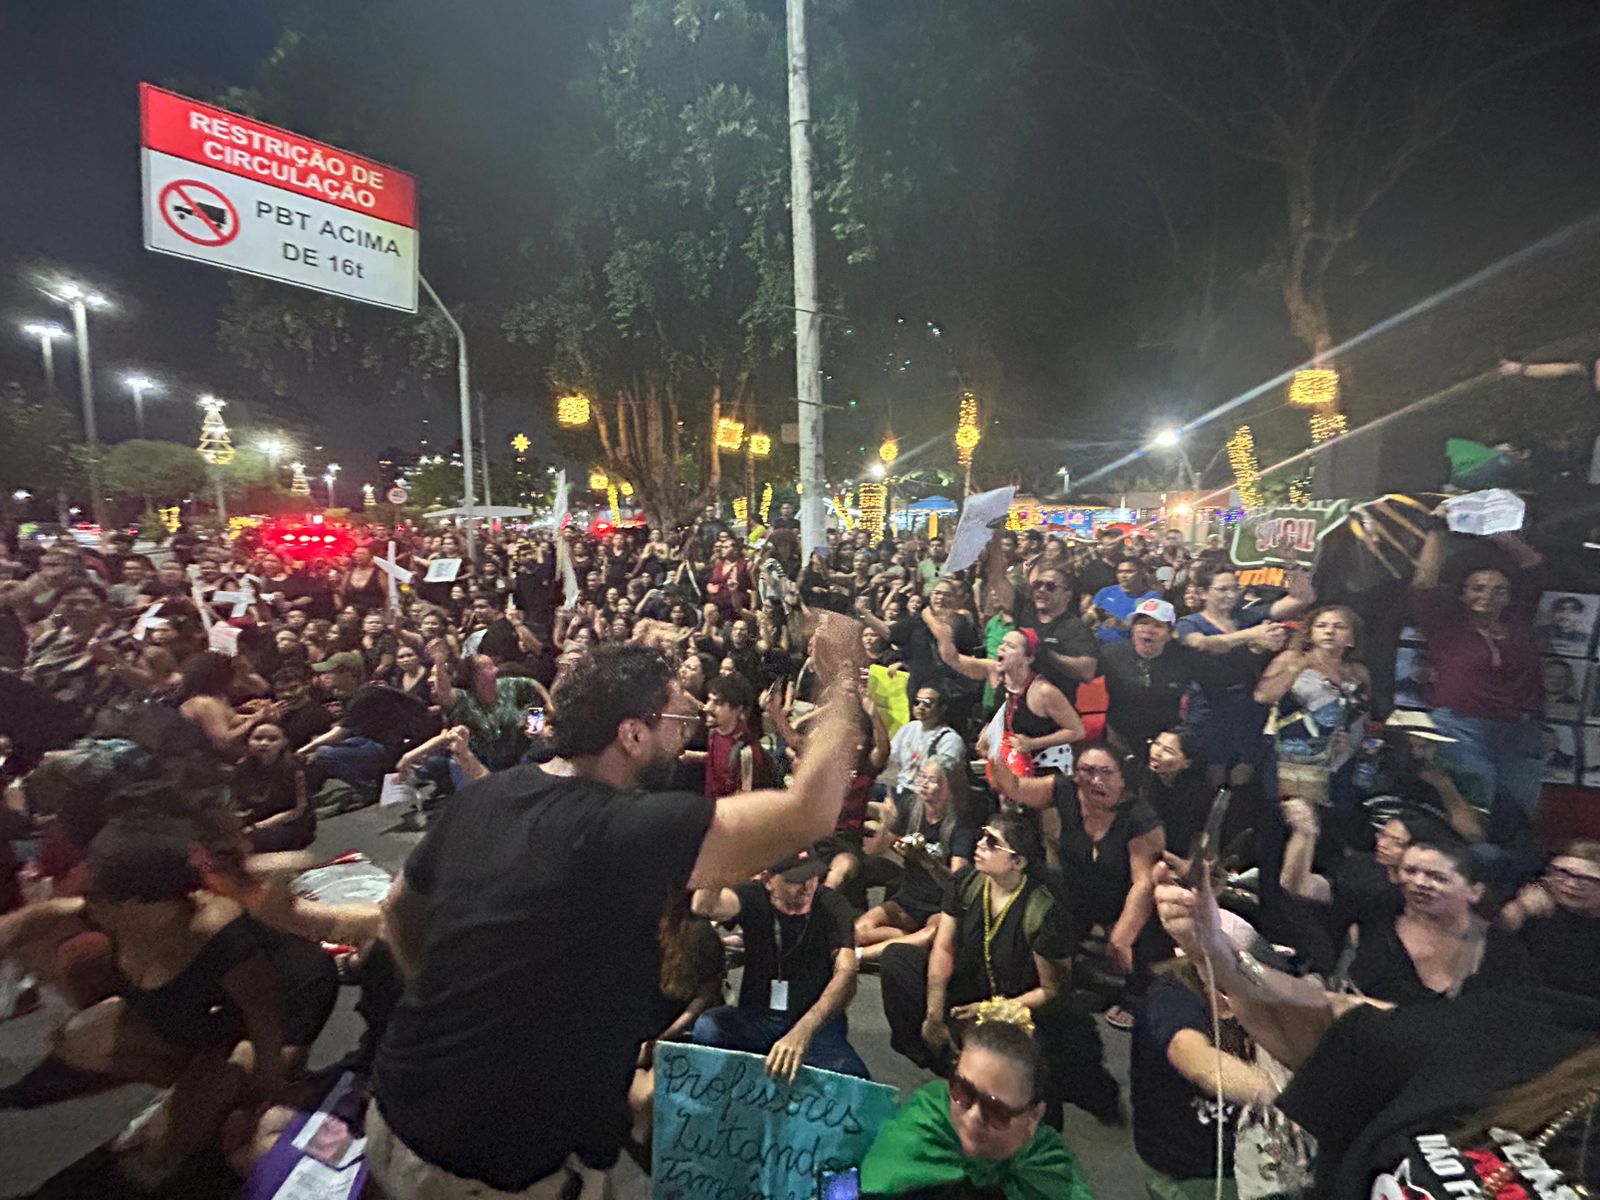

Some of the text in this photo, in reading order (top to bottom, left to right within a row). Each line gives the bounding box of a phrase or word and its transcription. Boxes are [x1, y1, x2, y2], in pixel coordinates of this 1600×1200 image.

[189, 111, 384, 190] RESTRIÇÃO DE
[203, 140, 376, 208] CIRCULAÇÃO
[256, 200, 401, 257] PBT ACIMA
[282, 242, 365, 279] DE 16t
[664, 1053, 863, 1134] Professores
